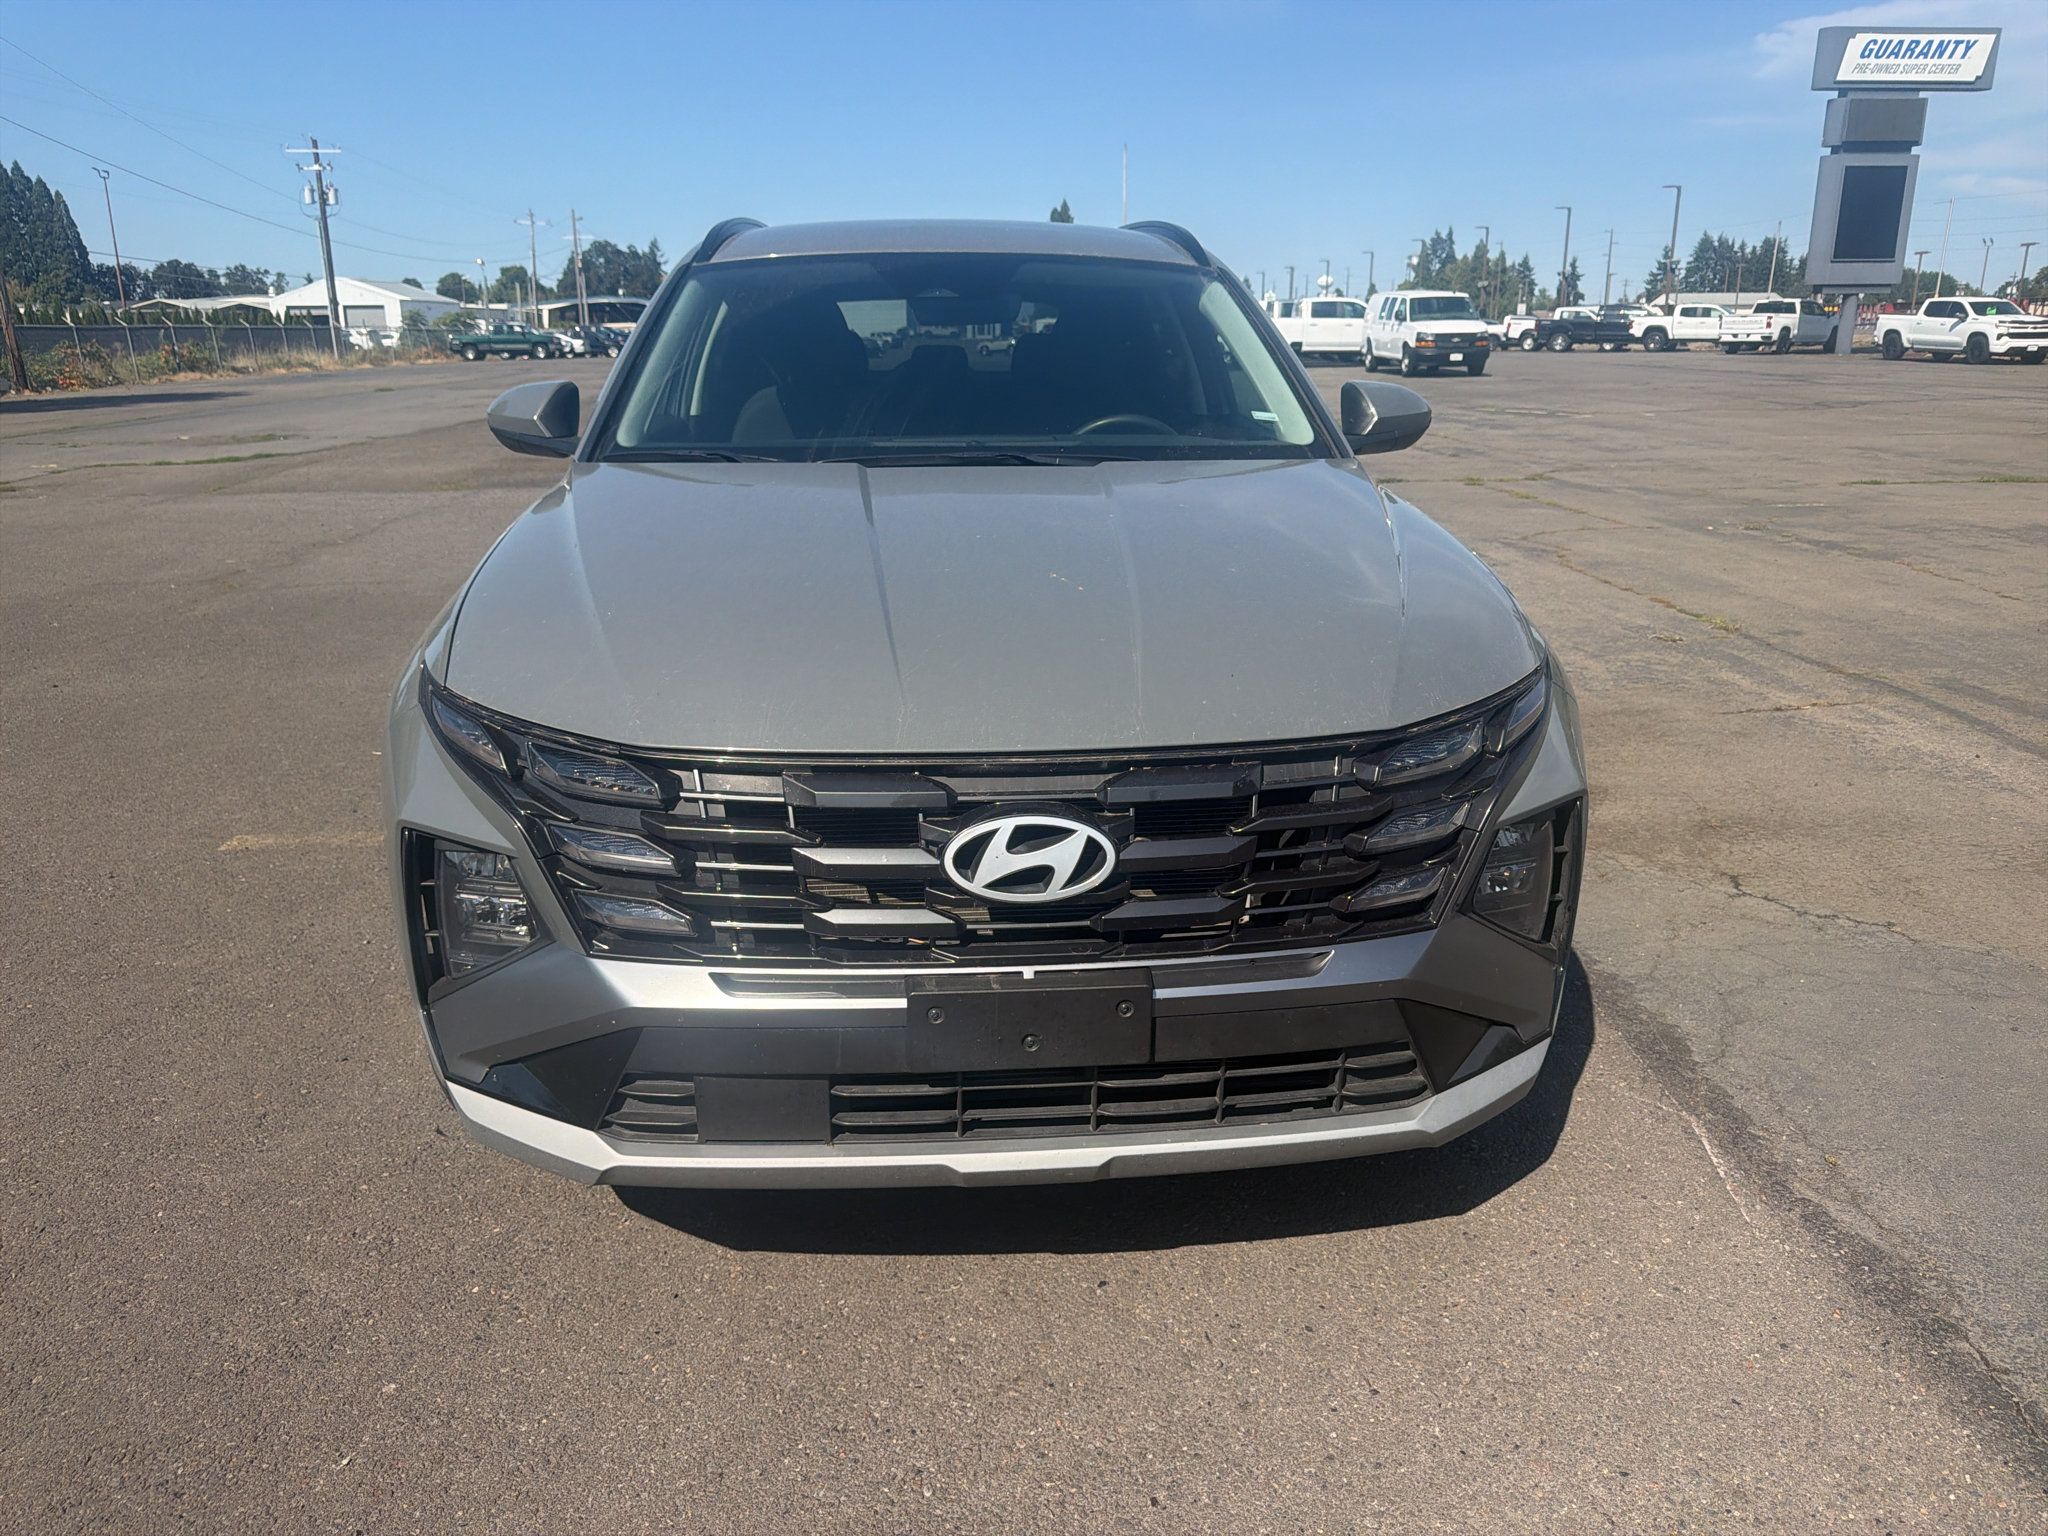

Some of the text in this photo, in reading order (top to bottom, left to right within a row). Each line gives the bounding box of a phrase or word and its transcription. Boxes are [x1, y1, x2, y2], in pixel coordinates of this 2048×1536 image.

[1860, 39, 1979, 60] GUARANTY
[1851, 62, 1962, 75] PRE-OWNED SUPER CENTER
